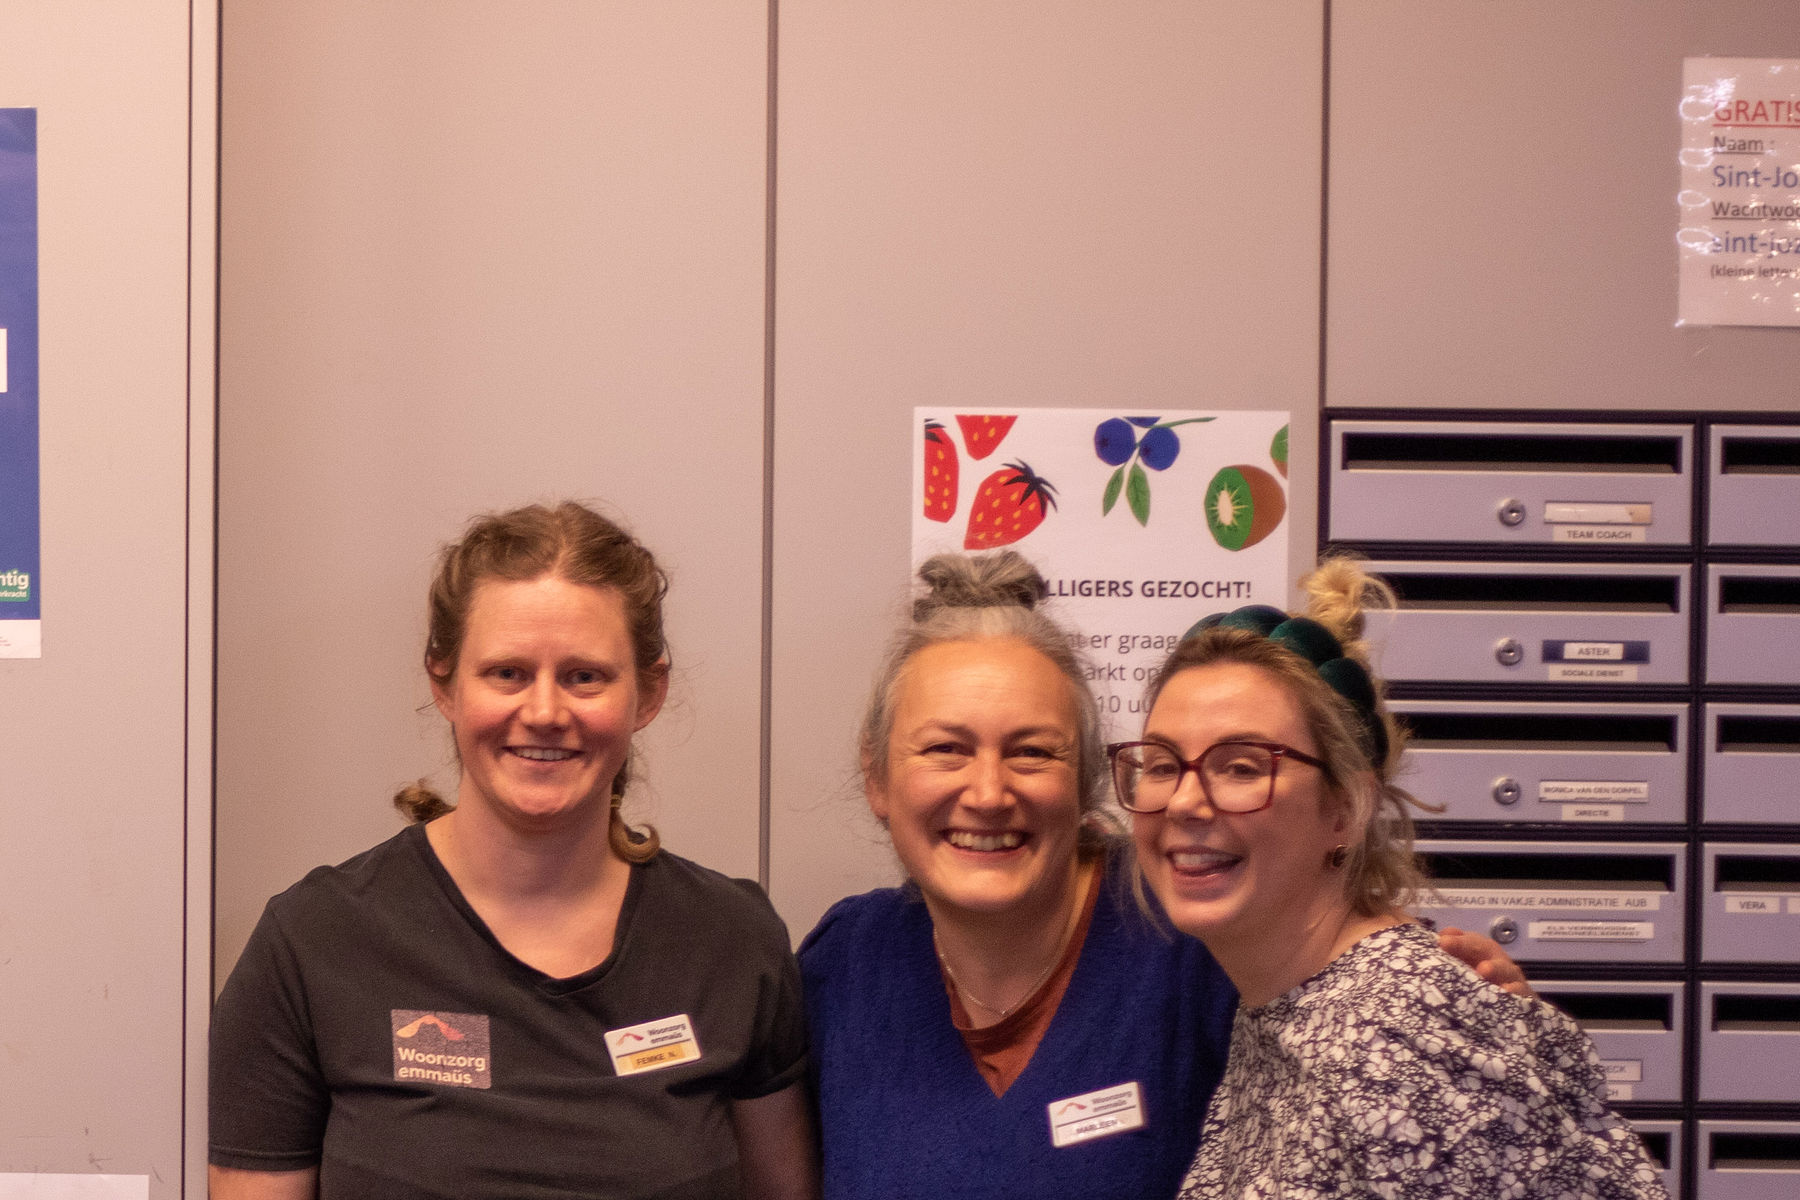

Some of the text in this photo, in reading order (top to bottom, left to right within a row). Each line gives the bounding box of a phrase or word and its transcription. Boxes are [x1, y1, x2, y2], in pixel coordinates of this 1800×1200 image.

[1714, 136, 1763, 151] Naam
[1567, 530, 1632, 539] TEAM COACH
[1141, 581, 1251, 598] GEZOCHT!
[1090, 634, 1112, 648] er
[1578, 648, 1610, 656] ASTER
[1488, 897, 1499, 905] IN
[1502, 897, 1534, 906] VAKJE
[1538, 897, 1618, 907] ADMINISTRATIE
[1625, 898, 1647, 907] AUB
[1739, 901, 1766, 909] VERA
[398, 1047, 486, 1071] Woonzorg
[398, 1064, 473, 1085] emmaüs
